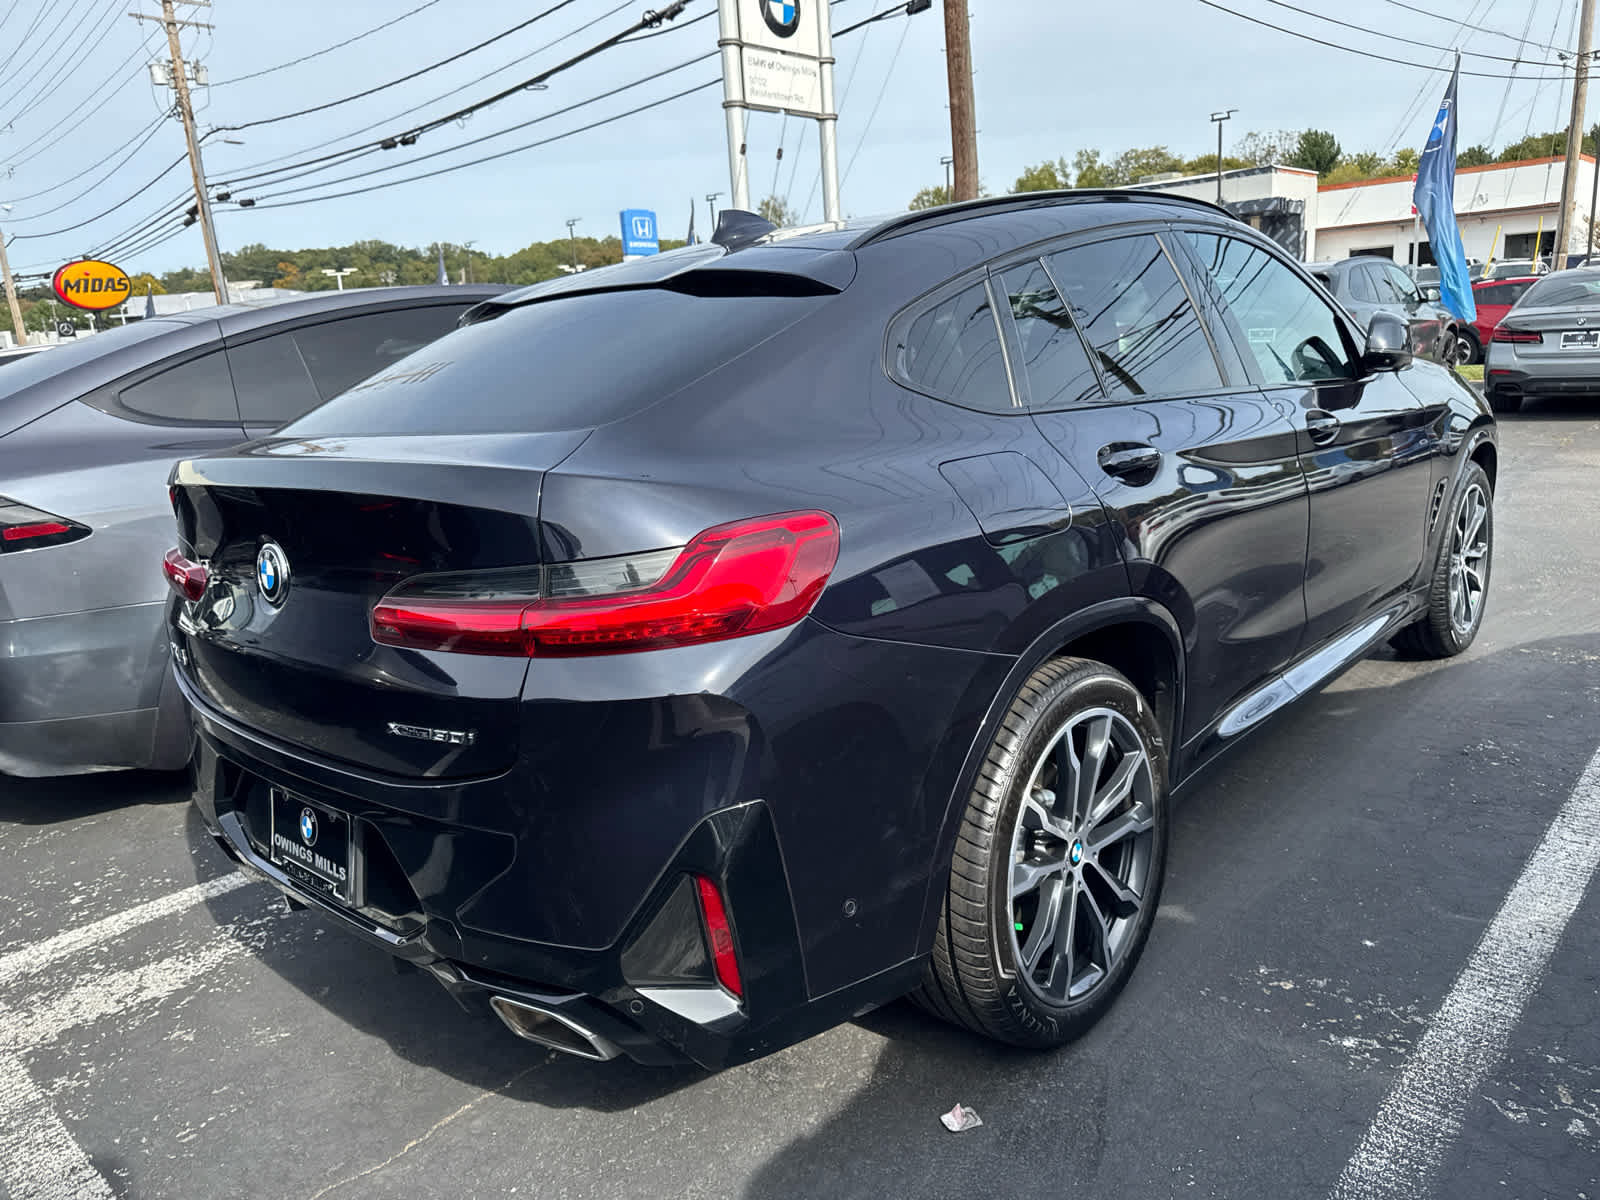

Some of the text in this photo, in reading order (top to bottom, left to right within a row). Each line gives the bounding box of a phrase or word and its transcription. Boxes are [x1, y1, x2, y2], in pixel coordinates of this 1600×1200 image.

[63, 272, 129, 294] MIDAS
[274, 833, 313, 862] OWINGS
[314, 853, 346, 881] MILLS
